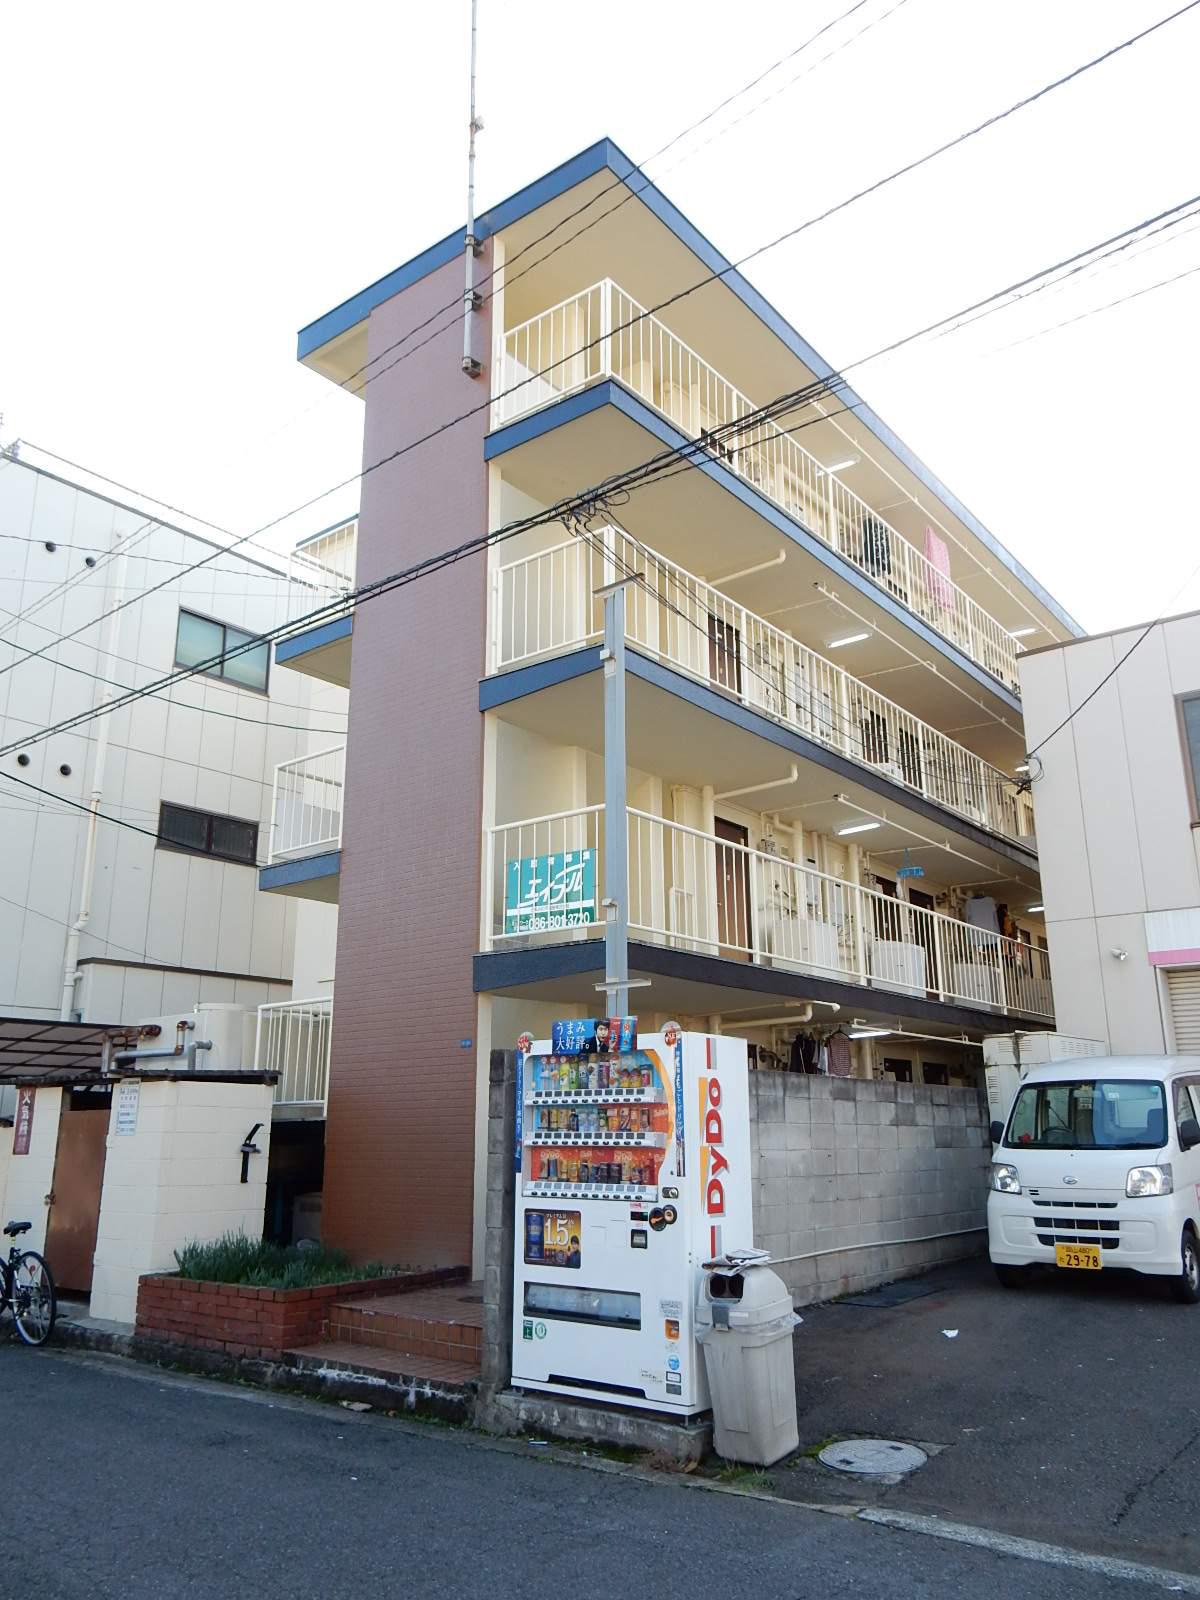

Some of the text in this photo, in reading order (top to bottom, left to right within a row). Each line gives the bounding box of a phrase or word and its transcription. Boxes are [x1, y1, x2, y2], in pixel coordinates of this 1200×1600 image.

[518, 863, 585, 907] エイブル
[556, 1021, 586, 1035] うまみ
[556, 1036, 590, 1050] 大好評。
[1066, 1254, 1098, 1267] 29-78
